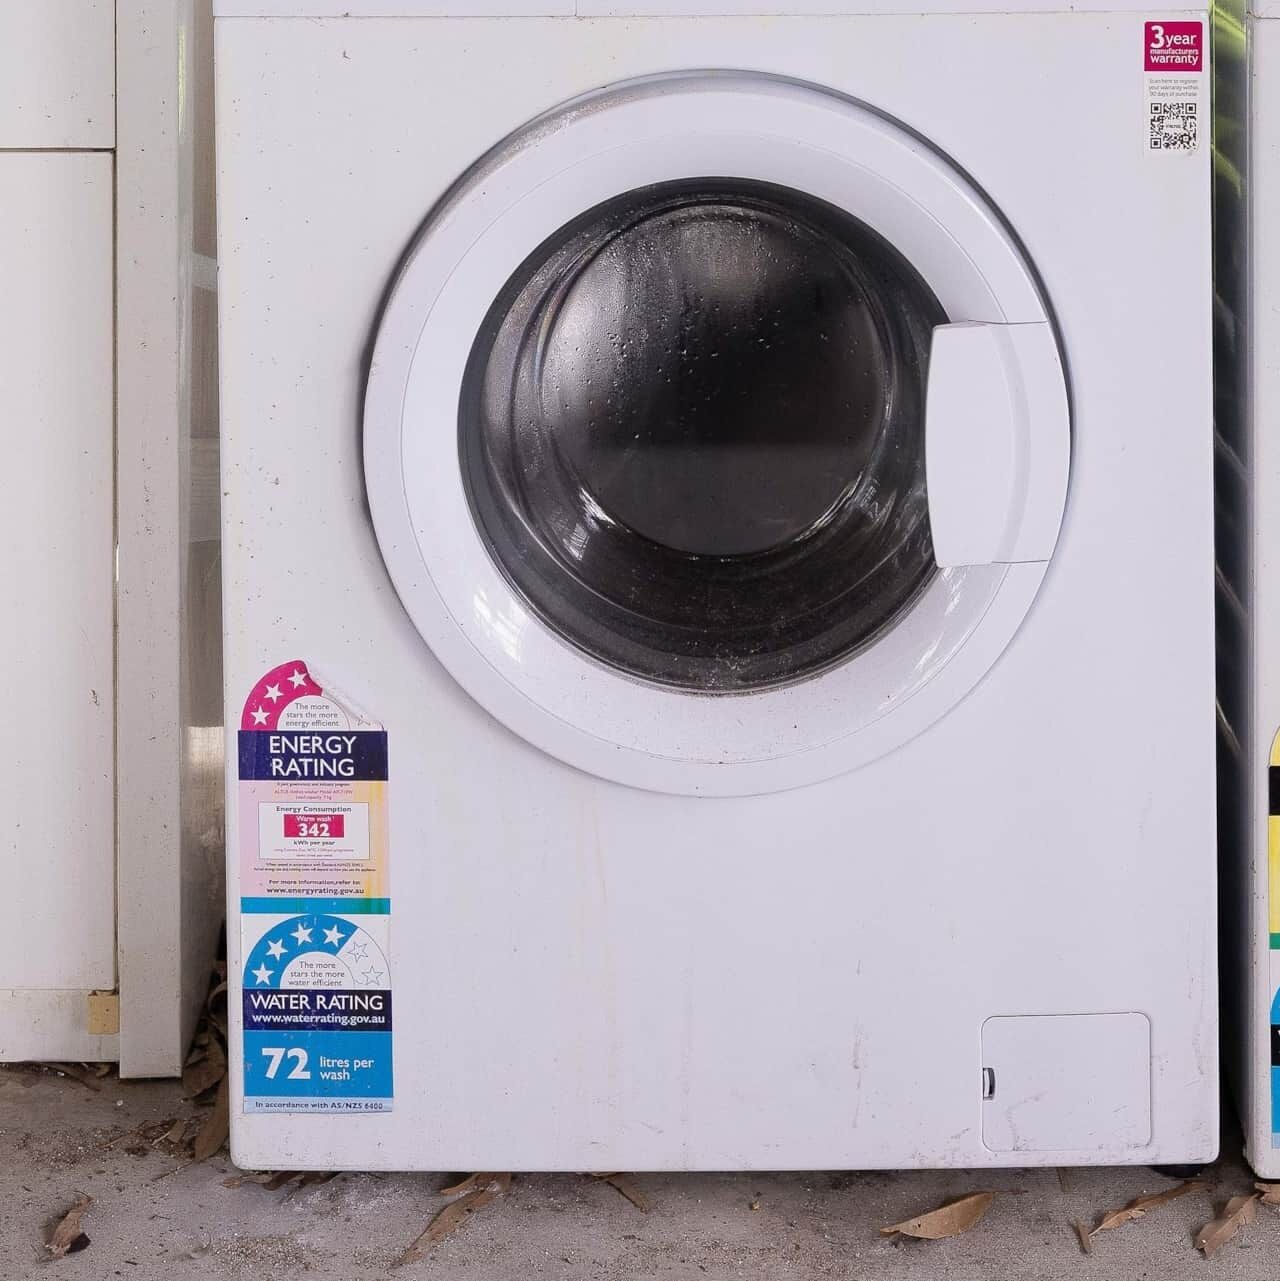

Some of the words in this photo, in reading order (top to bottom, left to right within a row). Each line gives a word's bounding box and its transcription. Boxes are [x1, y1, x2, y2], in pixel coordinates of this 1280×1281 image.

[1150, 25, 1165, 48] 3
[1165, 34, 1197, 47] year
[1151, 54, 1199, 65] warranty
[295, 703, 308, 711] The
[305, 711, 317, 719] the
[270, 736, 357, 754] ENERGY
[272, 759, 354, 776] RATING
[298, 823, 330, 837] 342
[300, 961, 314, 969] The
[251, 994, 311, 1010] WATER
[317, 995, 383, 1010] RATING
[252, 1013, 385, 1025] www.waterrating.gov.au
[262, 1048, 311, 1079] 72
[320, 1056, 349, 1068] litres
[353, 1059, 374, 1071] per
[320, 1069, 350, 1080] wash
